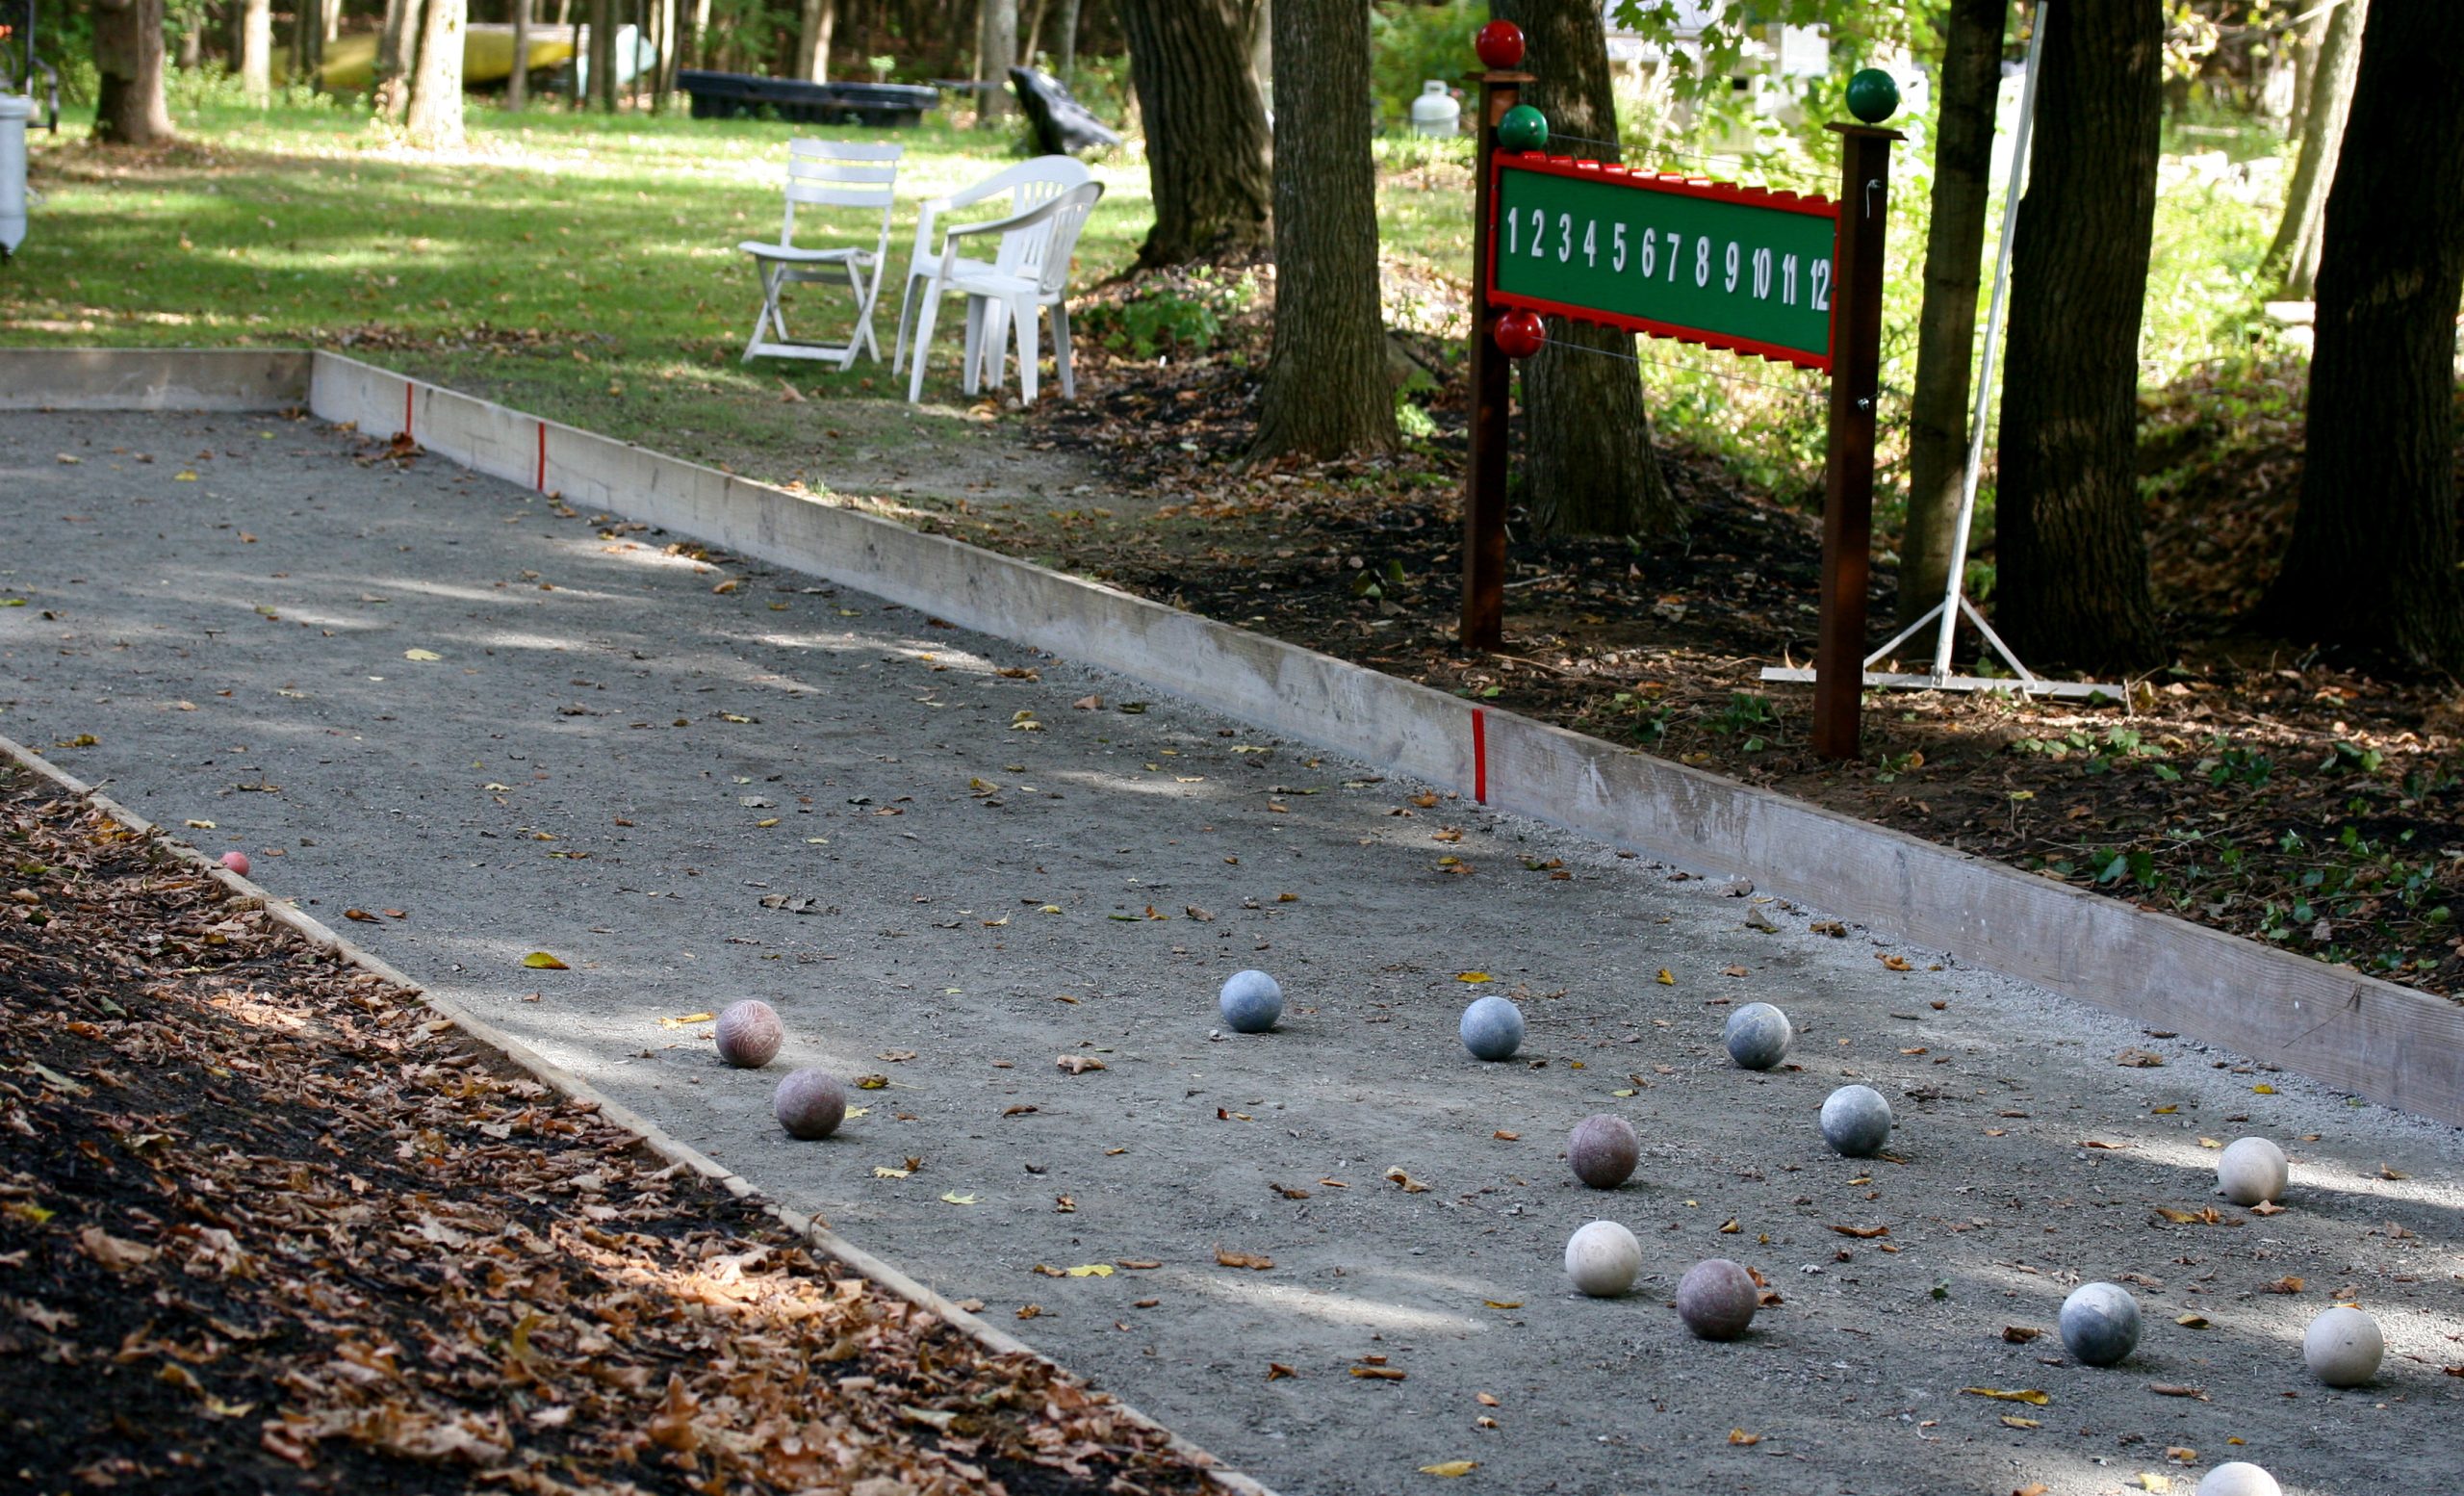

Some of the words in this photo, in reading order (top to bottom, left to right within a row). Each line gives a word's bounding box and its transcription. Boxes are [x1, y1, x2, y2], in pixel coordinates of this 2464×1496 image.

[1508, 208, 1517, 253] 1
[1531, 210, 1544, 257] 2
[1559, 214, 1571, 262] 3
[1584, 220, 1596, 267] 4
[1613, 223, 1626, 271] 5
[1642, 228, 1656, 277] 6
[1667, 233, 1680, 281] 7
[1696, 237, 1709, 287] 8
[1726, 242, 1739, 293] 9
[1753, 248, 1771, 299] 10
[1783, 254, 1797, 304] 11
[1810, 259, 1831, 311] 12
